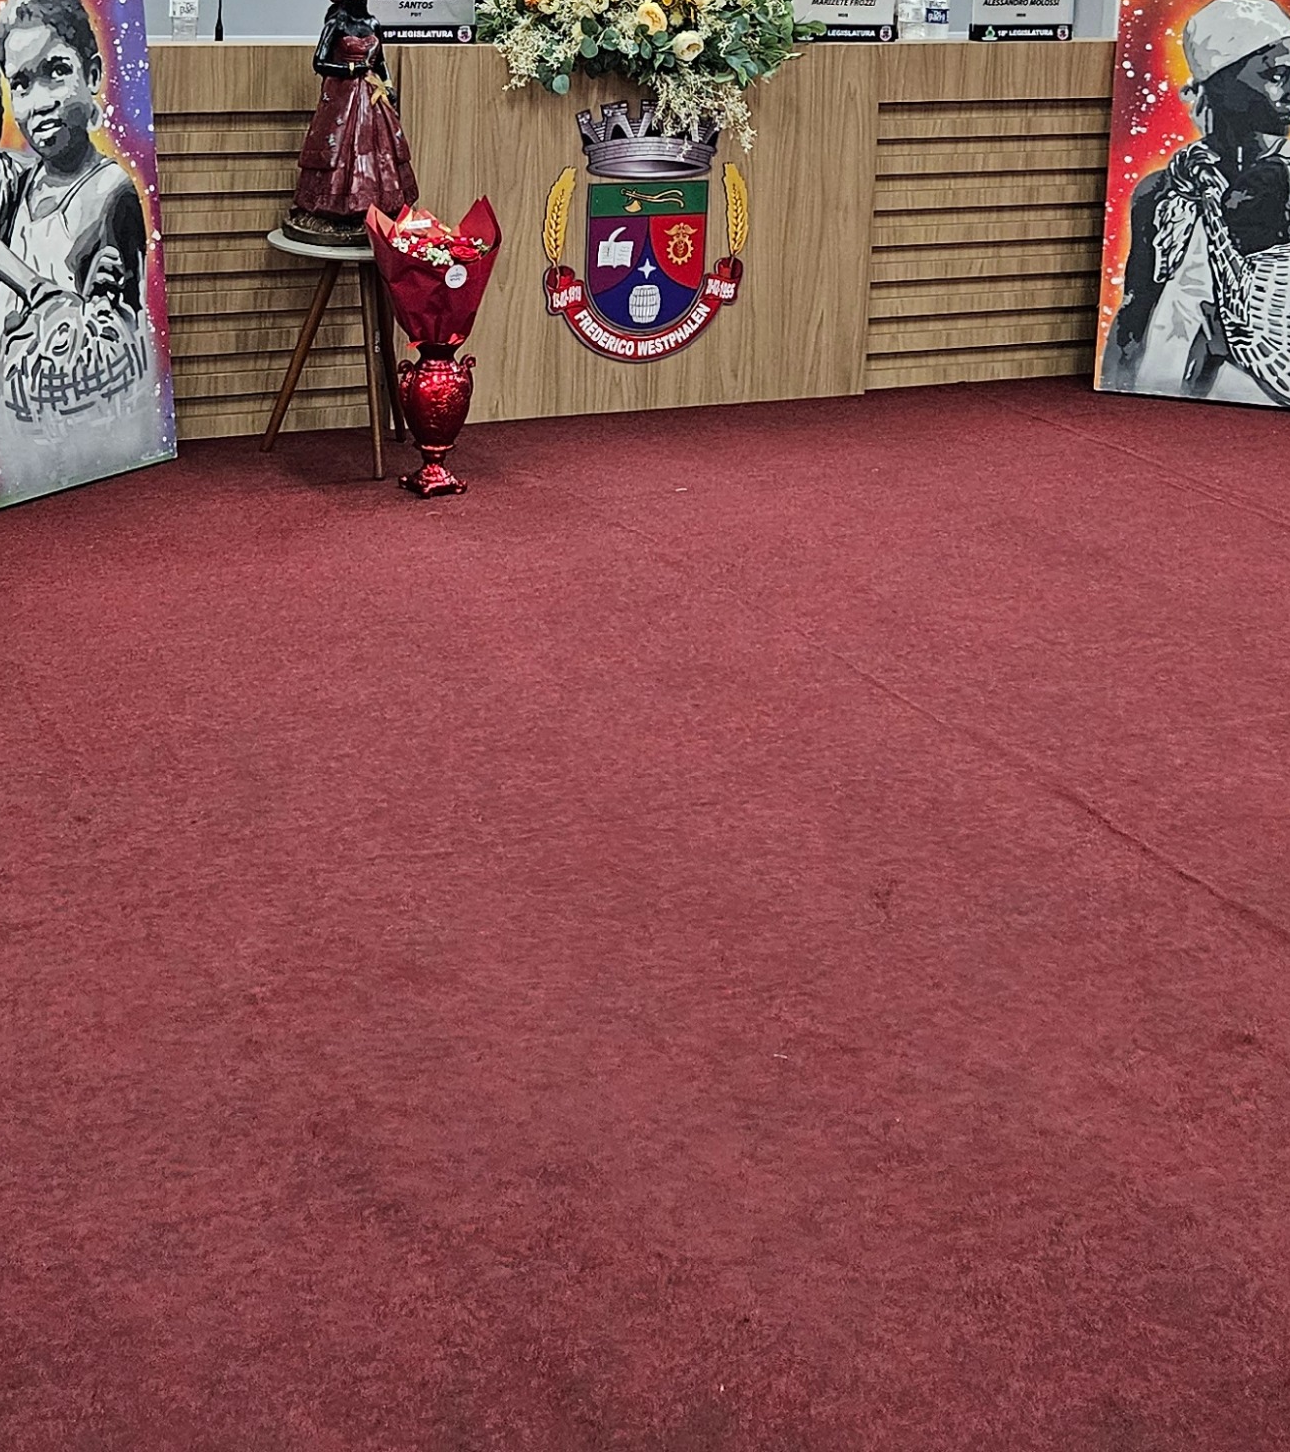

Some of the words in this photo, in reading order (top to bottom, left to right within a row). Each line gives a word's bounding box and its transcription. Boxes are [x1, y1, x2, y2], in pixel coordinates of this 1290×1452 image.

[398, 1, 433, 9] SANTOS
[397, 29, 453, 38] LEGISLATURA
[827, 29, 876, 37] LEGISLATURA
[574, 309, 634, 357] FREDERICO
[637, 302, 711, 357] WESTPHALEN
